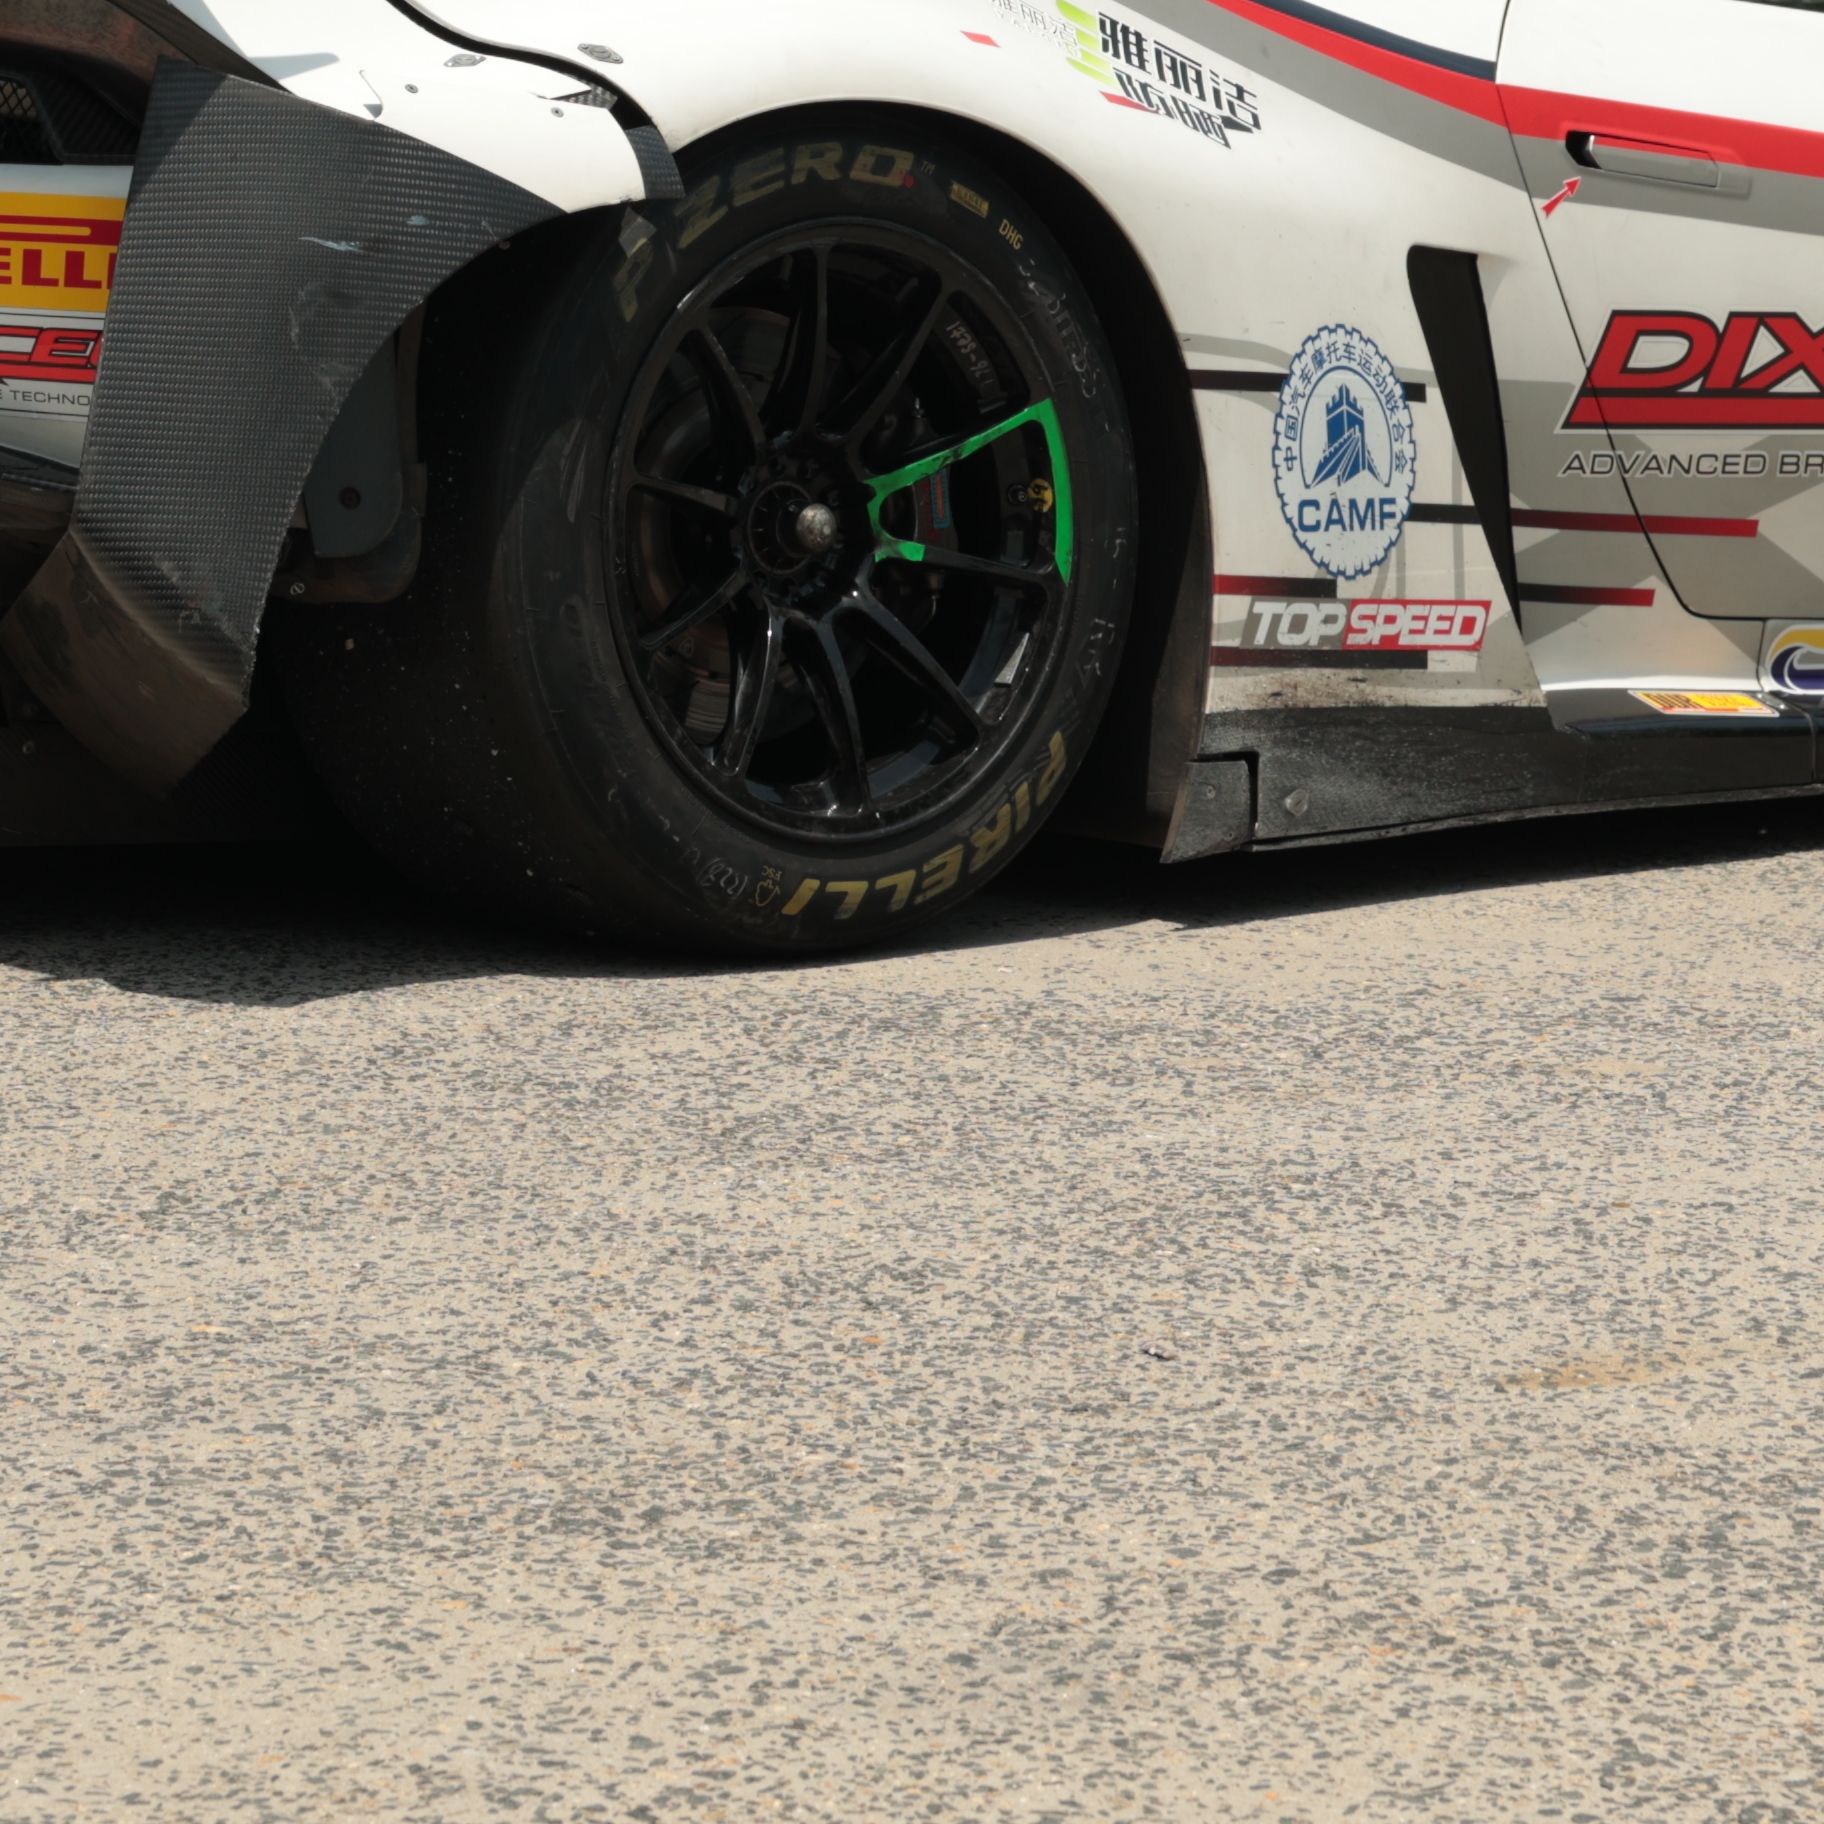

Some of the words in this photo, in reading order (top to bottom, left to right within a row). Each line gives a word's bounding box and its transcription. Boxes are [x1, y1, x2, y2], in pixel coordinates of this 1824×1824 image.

[1098, 11, 1262, 131] 雅丽洁
[998, 218, 1024, 250] DHG
[1284, 340, 1409, 474] 中国汽车摩托车运动联合会
[1560, 452, 1768, 476] ADVANCED
[1297, 497, 1397, 533] CAMF
[1251, 602, 1347, 646] TOP
[1346, 602, 1488, 647] SPEED
[780, 729, 1067, 921] PIRELLI
